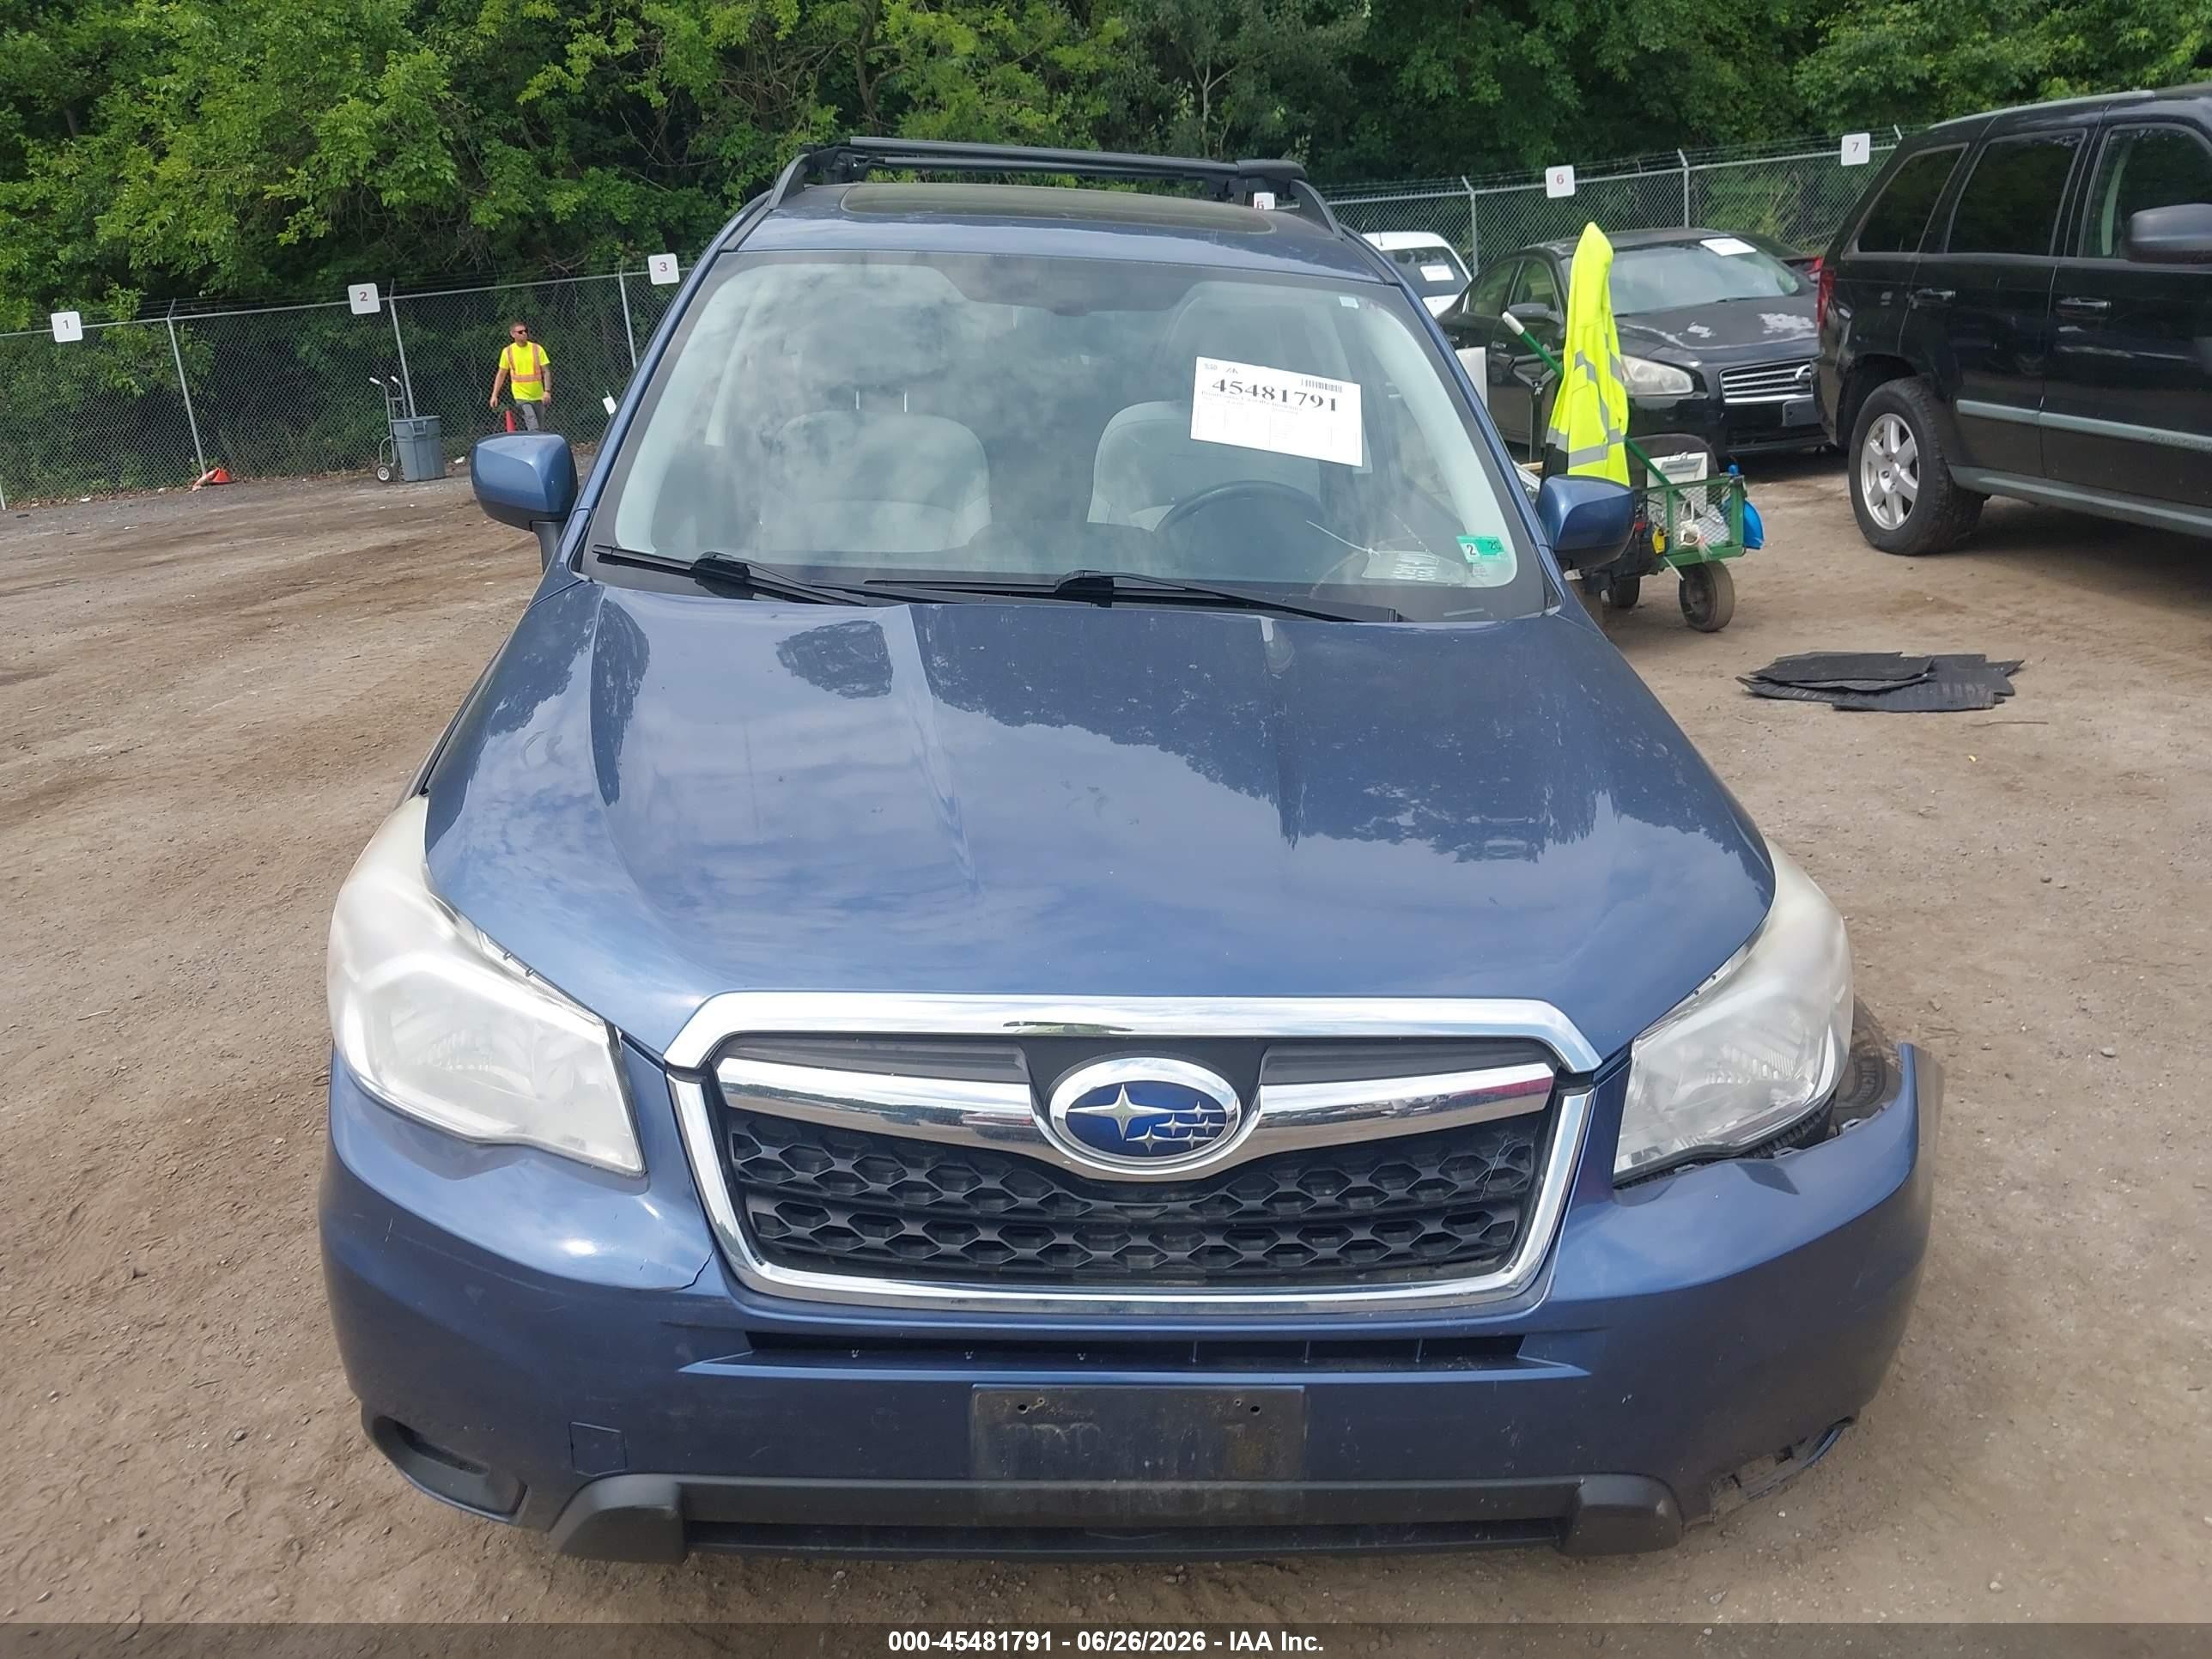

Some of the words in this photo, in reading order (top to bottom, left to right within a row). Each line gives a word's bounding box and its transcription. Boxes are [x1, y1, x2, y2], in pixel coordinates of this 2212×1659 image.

[1852, 142, 1859, 152] 7
[1557, 174, 1564, 185] 6
[659, 262, 667, 272] 3
[359, 291, 368, 301] 2
[63, 319, 69, 329] 1
[1211, 378, 1336, 412] 45481791
[1466, 544, 1476, 556] 2
